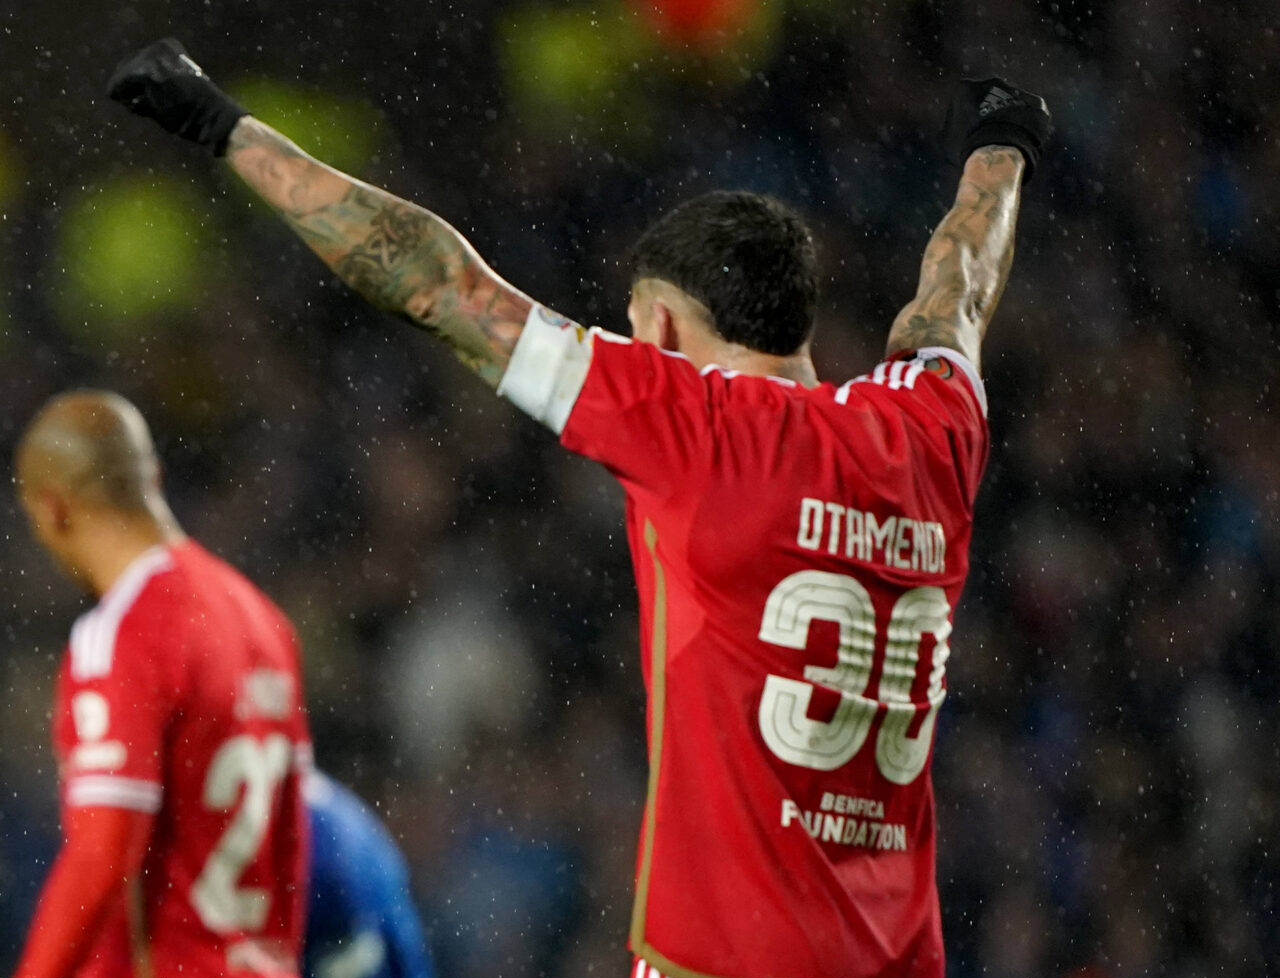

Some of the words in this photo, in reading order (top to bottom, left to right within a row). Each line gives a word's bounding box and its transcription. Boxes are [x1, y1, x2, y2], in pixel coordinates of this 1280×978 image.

[797, 497, 946, 574] OTAMENDI
[758, 569, 952, 785] 30
[820, 792, 884, 821] BENFICA
